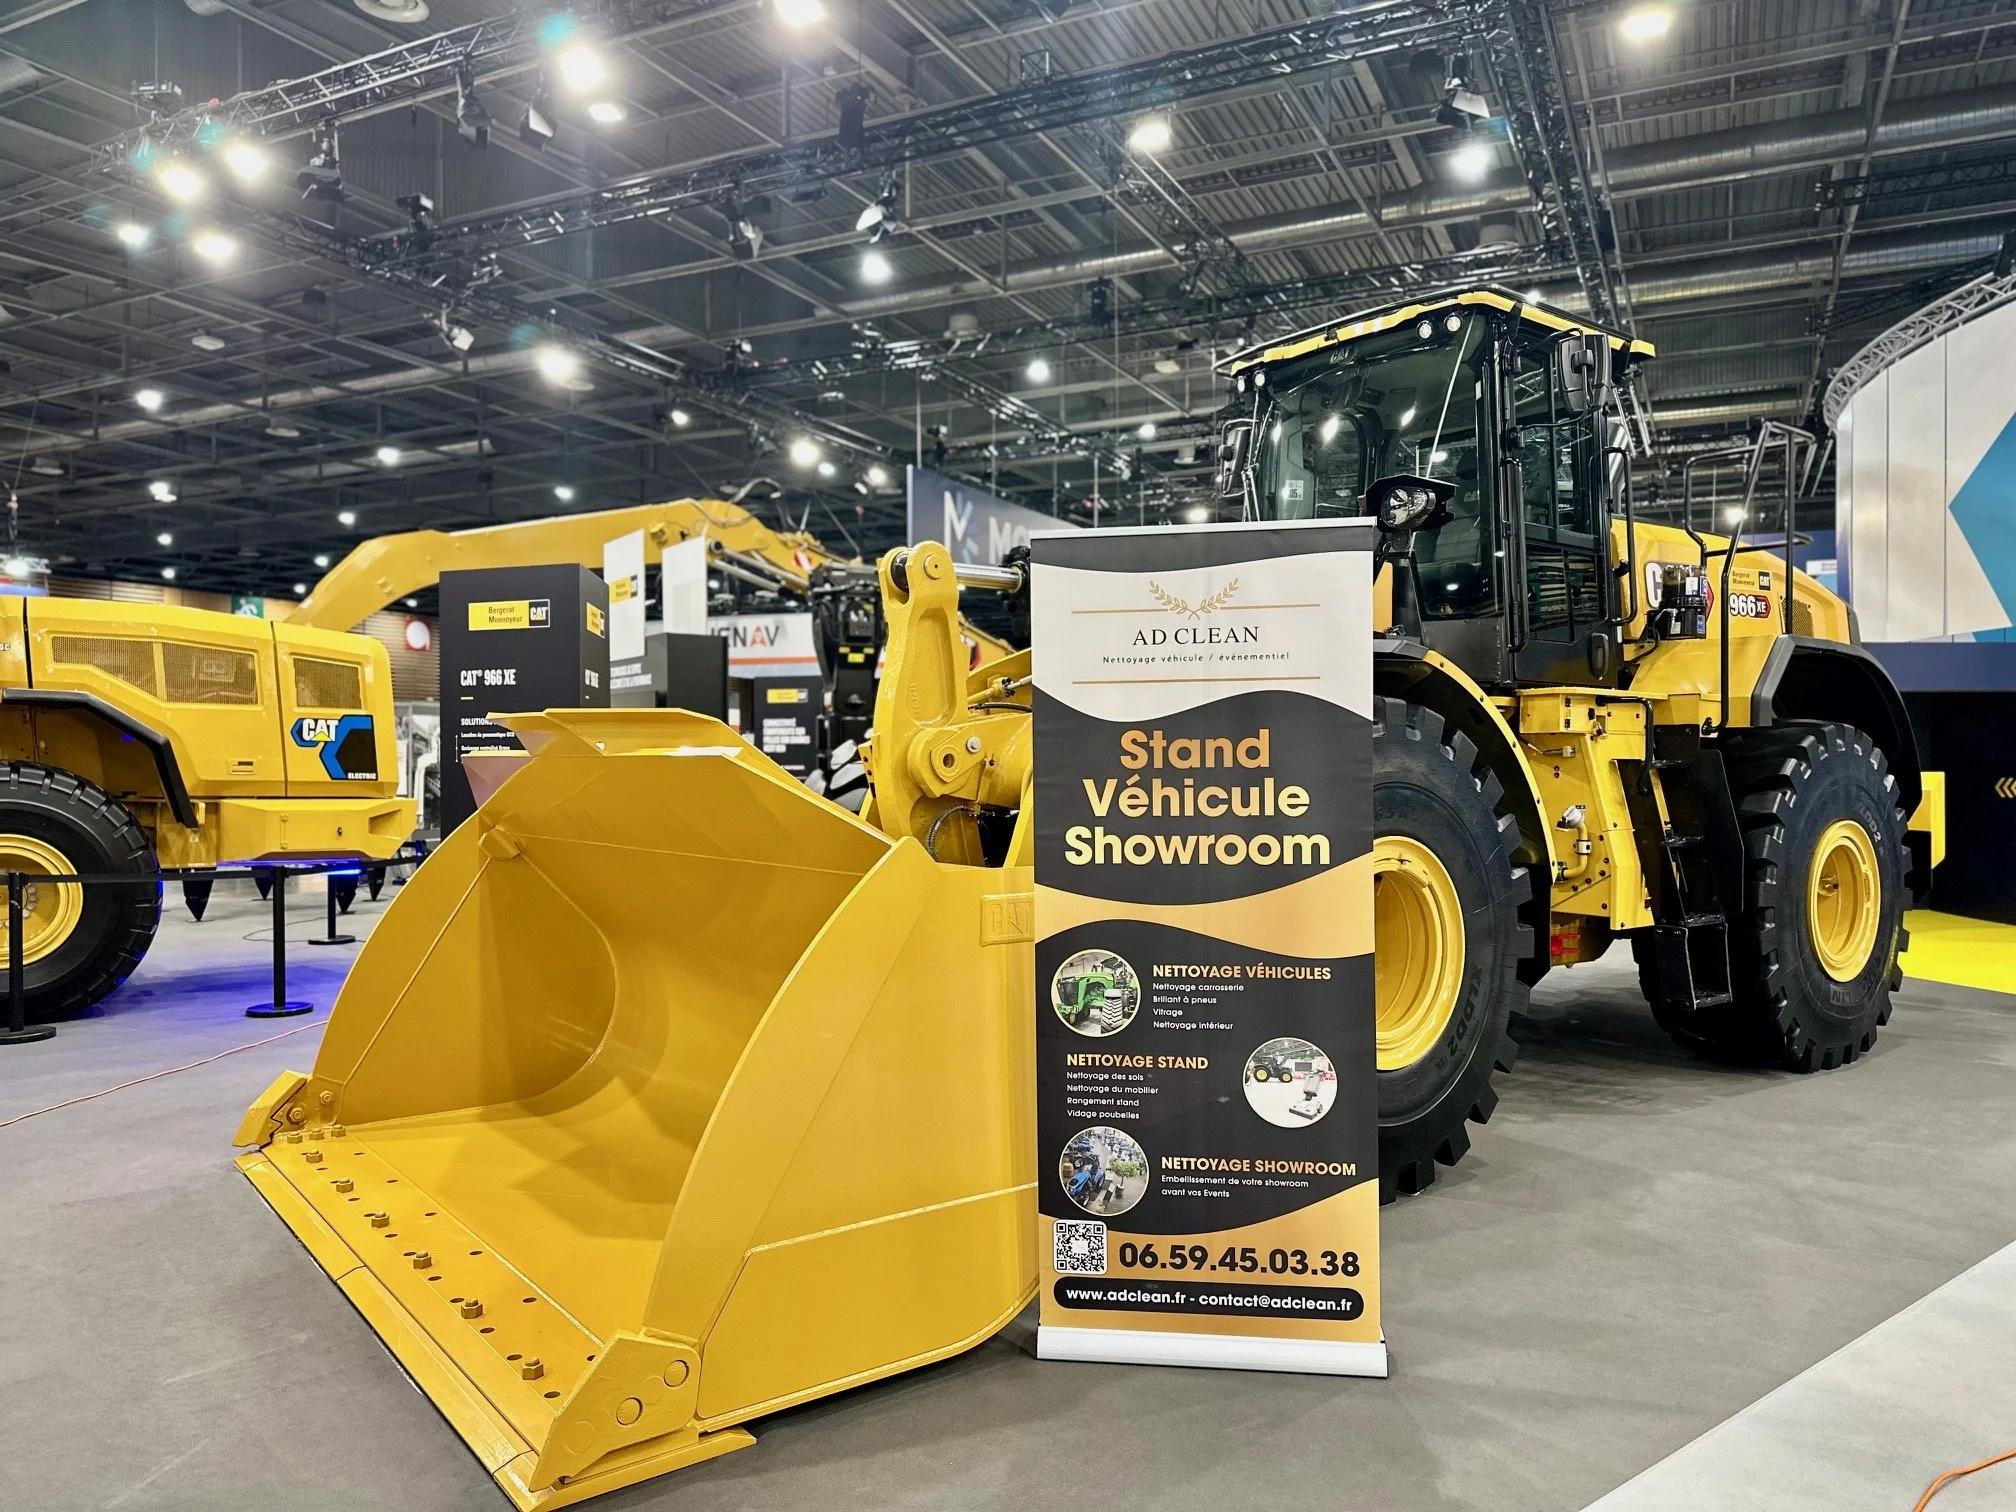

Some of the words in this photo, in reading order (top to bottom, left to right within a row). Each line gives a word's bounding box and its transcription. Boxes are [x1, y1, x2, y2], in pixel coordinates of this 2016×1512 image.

[1729, 594, 1756, 617] 966
[1756, 601, 1767, 613] XE
[488, 606, 515, 615] Bergerat
[529, 606, 548, 621] CAT
[488, 615, 523, 624] Monnoyeur
[1132, 629, 1167, 646] AD
[1174, 626, 1260, 645] CLEAN
[1103, 655, 1156, 665] Nettoyage
[1161, 653, 1204, 662] véhicule
[1219, 651, 1290, 661] événementiel
[484, 669, 503, 686] 966
[503, 668, 517, 685] XE
[302, 718, 339, 742] CAT
[1119, 728, 1271, 770] Stand
[347, 772, 377, 780] ELECTRIC
[1081, 773, 1310, 818] Véhicule
[1064, 825, 1331, 866] Showroom
[1152, 964, 1242, 979] NETTOYAGE
[1245, 962, 1332, 980] VÉHICULES
[1152, 983, 1196, 992] Nettoyage
[1198, 984, 1244, 992] carrosserie
[1153, 996, 1181, 1004] Brillant
[1183, 996, 1190, 1004] à
[1191, 997, 1217, 1005] pneus
[1152, 1008, 1183, 1018] Vitrage
[1153, 1021, 1197, 1031] Nettoyage
[1198, 1021, 1234, 1030] intérieur
[1066, 1053, 1154, 1069] NETTOYAGE
[1157, 1056, 1209, 1070] STAND
[1066, 1072, 1109, 1081] Nettoyage
[1111, 1072, 1126, 1081] des
[1128, 1073, 1144, 1081] sols
[1066, 1084, 1109, 1094] Nettoyage
[1111, 1085, 1123, 1093] du
[1124, 1086, 1158, 1095] mobilier
[1066, 1097, 1114, 1106] Rangement
[1116, 1098, 1139, 1107] stand
[1066, 1109, 1097, 1119] Vidage
[1099, 1111, 1140, 1120] poubelles
[1161, 1156, 1251, 1172] NETTOYAGE
[1254, 1159, 1357, 1176] SHOWROOM
[1161, 1174, 1226, 1185] Embellissement
[1228, 1177, 1239, 1185] de
[1241, 1177, 1263, 1186] votre
[1264, 1178, 1309, 1187] showroom
[1161, 1188, 1186, 1196] avant
[1203, 1189, 1230, 1198] Events
[1118, 1241, 1361, 1278] 06.59.45.03.38
[1066, 1286, 1187, 1305] www.adclean.fr
[1198, 1292, 1353, 1312] contact@adclean.fr
